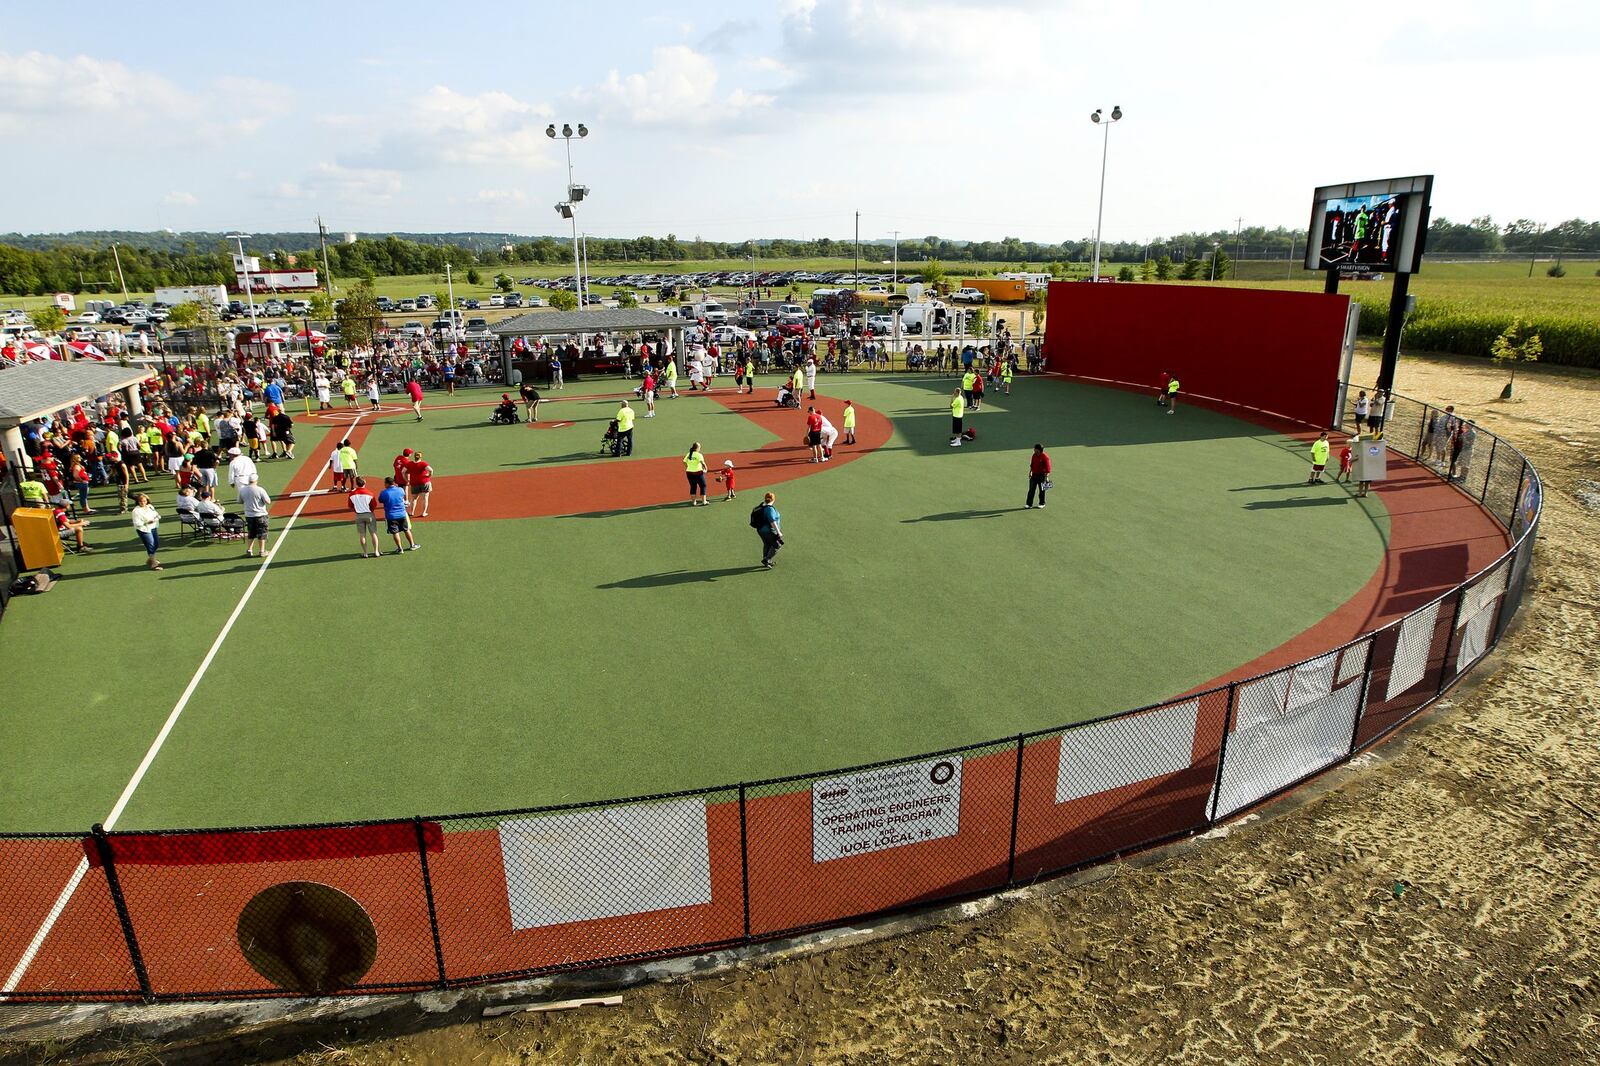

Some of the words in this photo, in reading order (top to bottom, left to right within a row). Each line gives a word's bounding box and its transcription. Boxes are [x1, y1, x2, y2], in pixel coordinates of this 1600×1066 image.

[821, 806, 886, 826] OPERATING
[889, 794, 952, 813] ENGINEERS
[831, 820, 884, 836] TRAINING
[887, 808, 942, 825] PROGRAM
[840, 839, 871, 854] IUOE
[875, 832, 914, 847] LOCAL
[919, 828, 932, 838] 18
